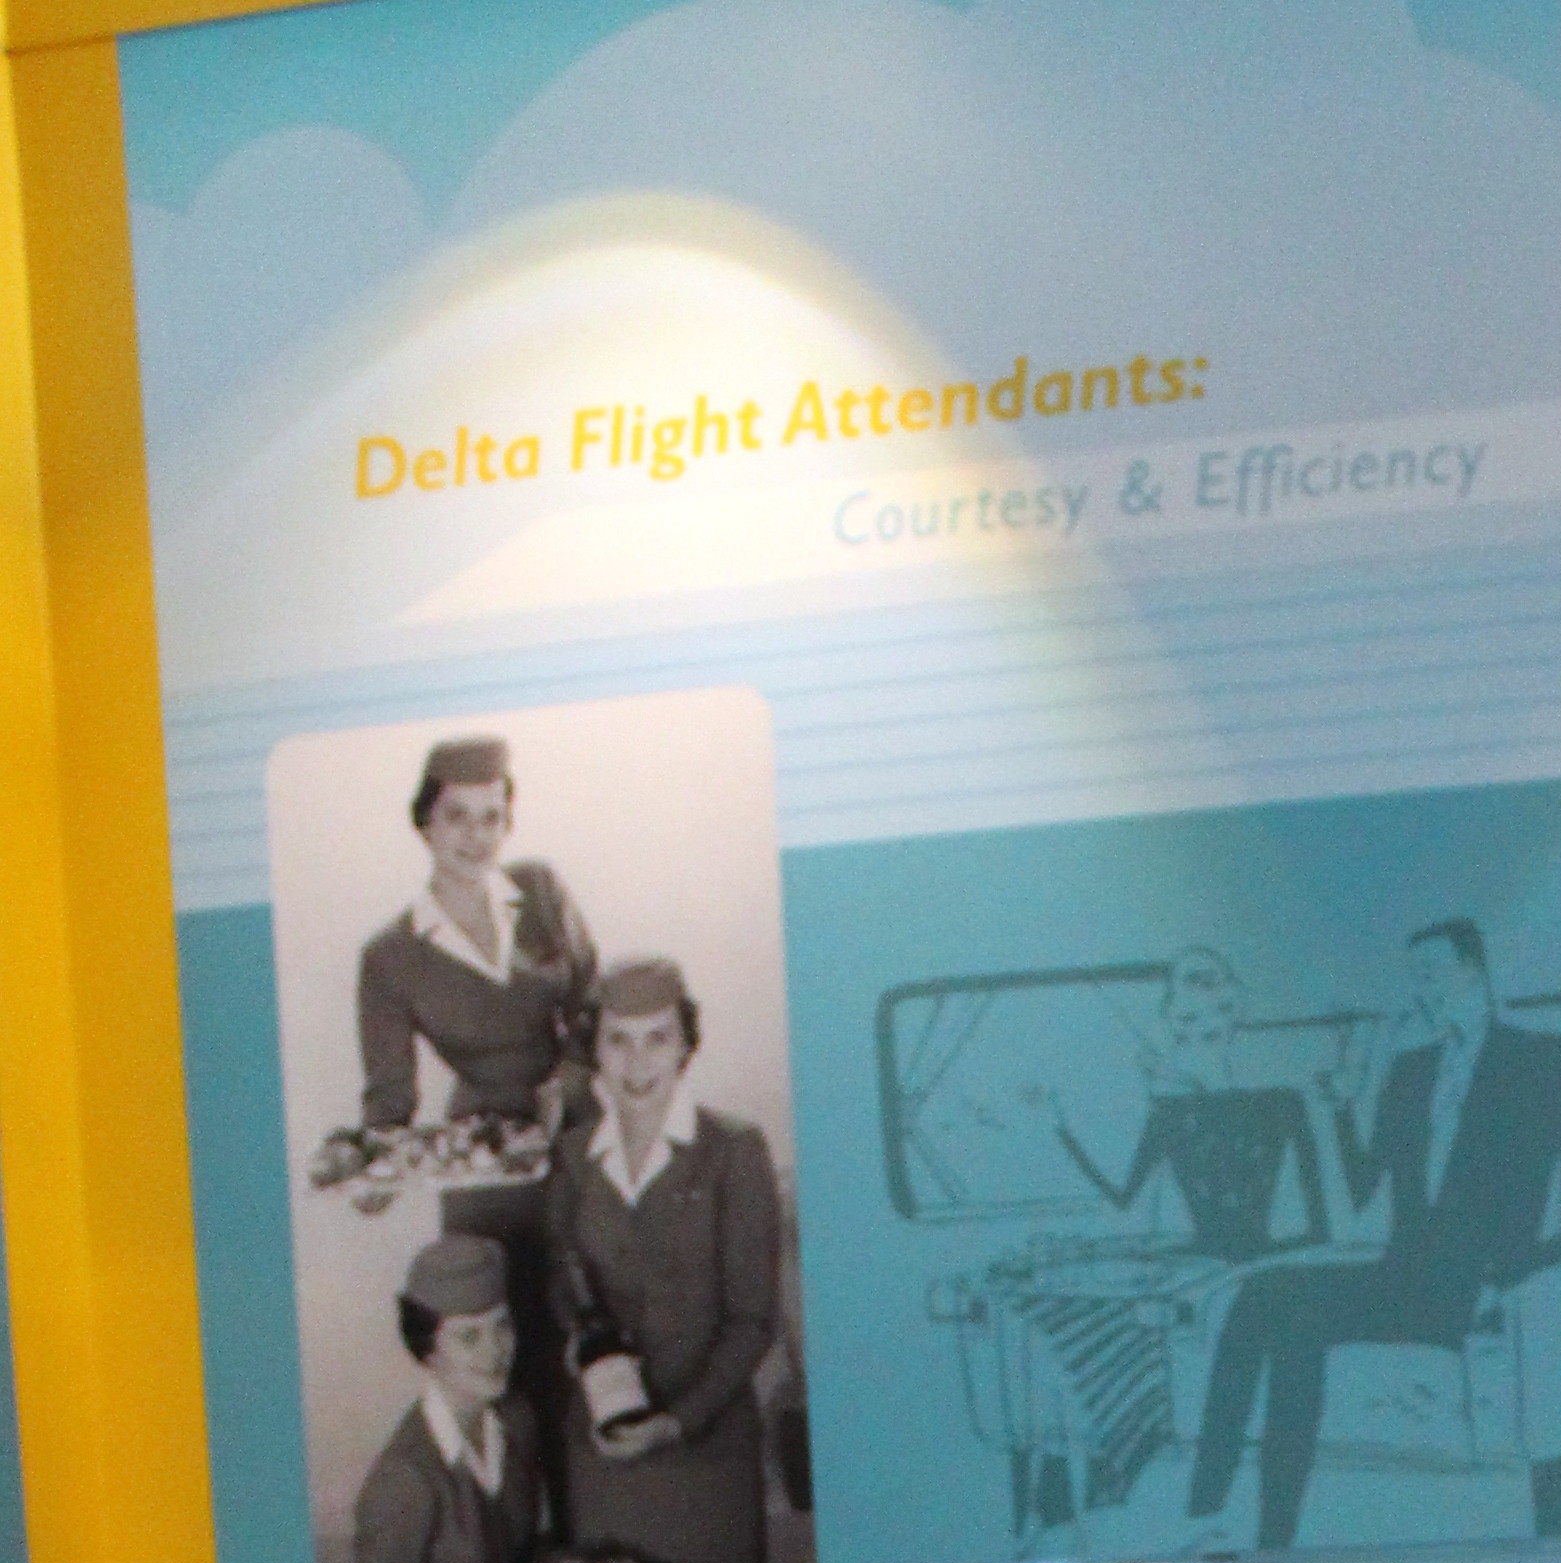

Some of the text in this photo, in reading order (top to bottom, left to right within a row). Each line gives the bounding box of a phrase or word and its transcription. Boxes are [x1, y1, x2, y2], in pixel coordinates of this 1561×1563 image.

[354, 352, 1207, 499] Delta Flight Attendants:
[834, 435, 1489, 546] Courtesy & Efficiency
